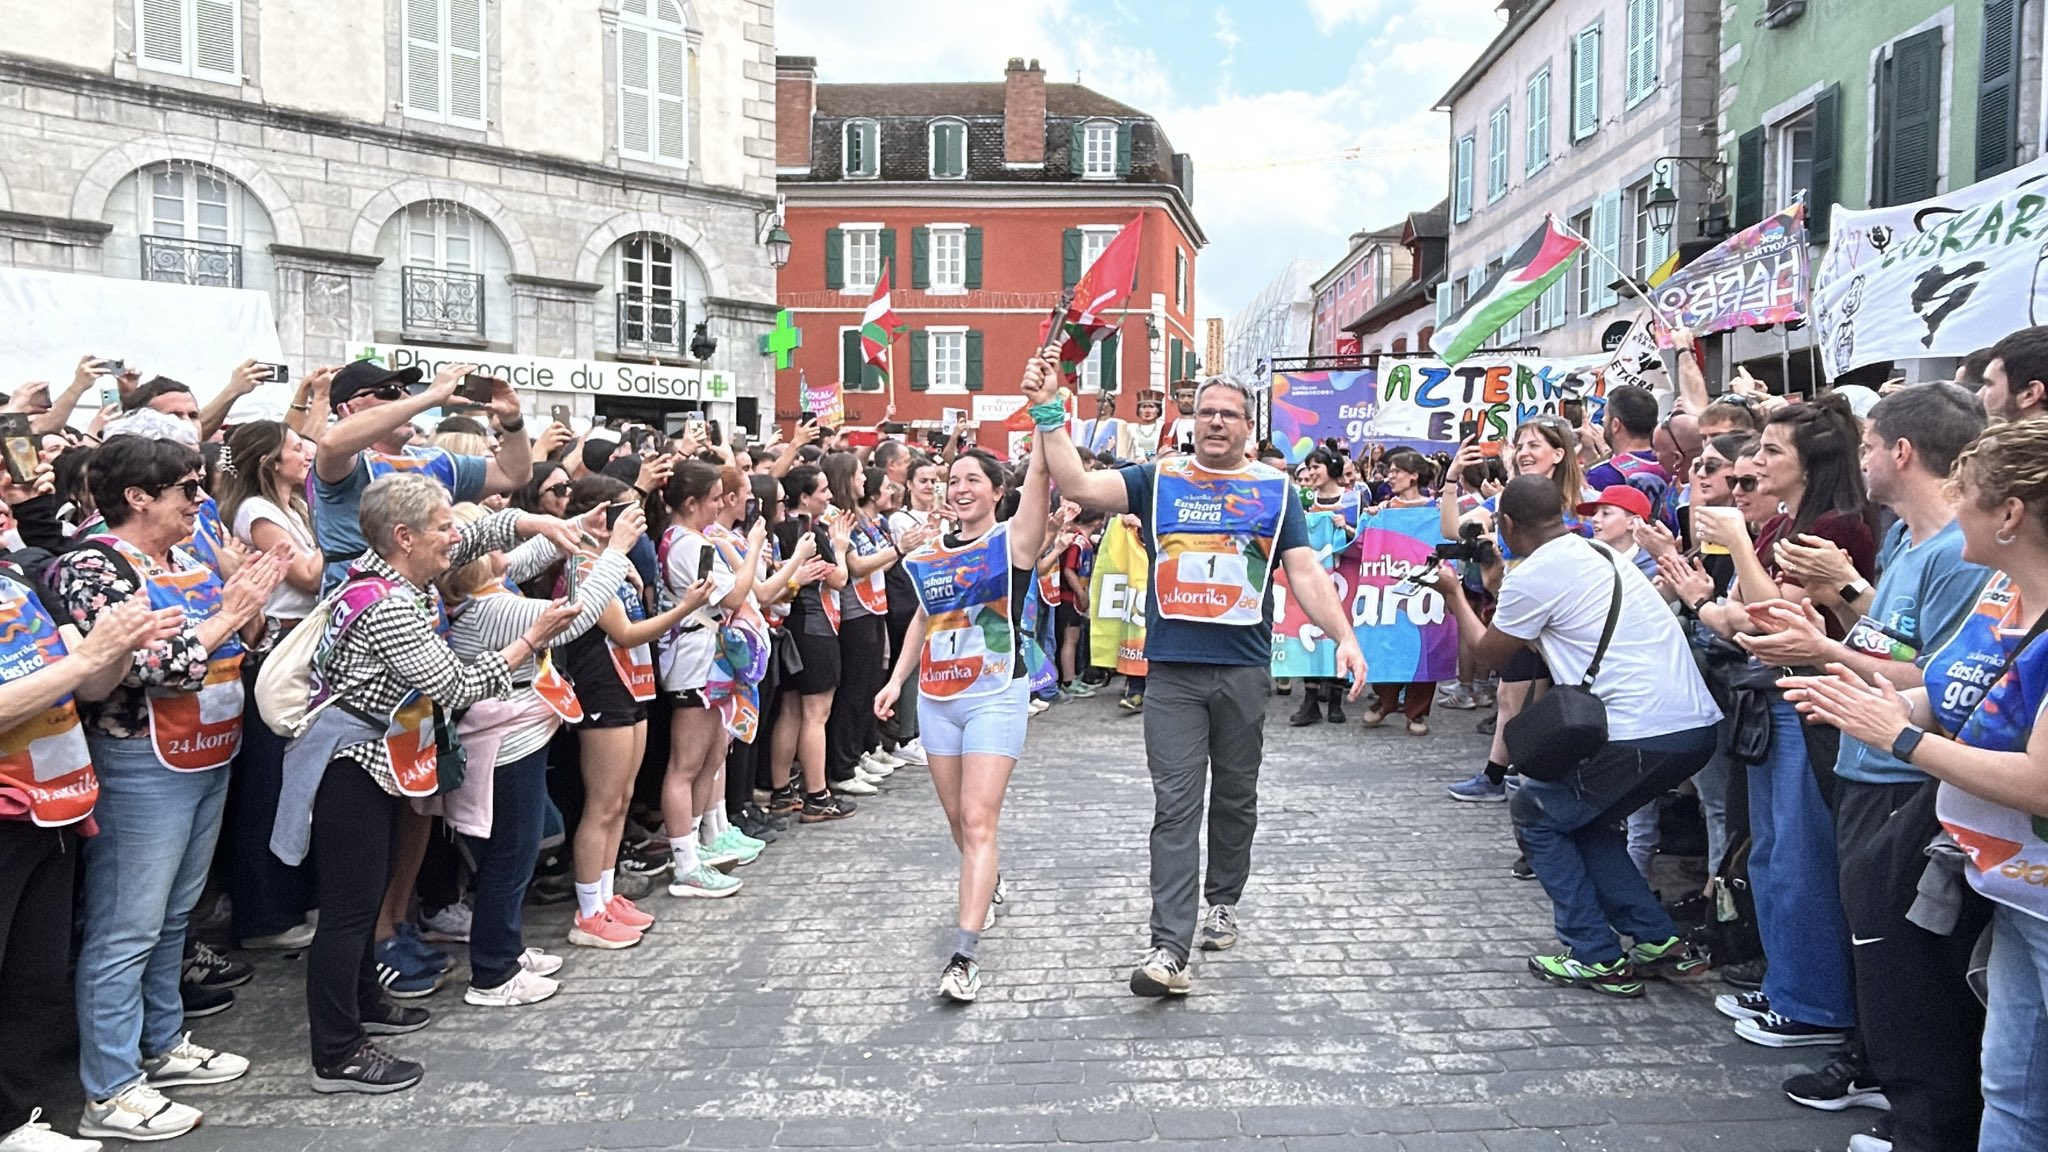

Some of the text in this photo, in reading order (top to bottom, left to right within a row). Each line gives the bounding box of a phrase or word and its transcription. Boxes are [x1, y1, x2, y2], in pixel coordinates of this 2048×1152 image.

[1882, 193, 2048, 269] EUSKAR
[394, 347, 702, 398] Phmacie du Saison
[1610, 360, 1654, 392] ETXERA
[1174, 498, 1222, 512] Euskara
[1178, 508, 1222, 523] gara
[1207, 554, 1217, 579] 1
[1162, 587, 1228, 607] 24.korrika
[950, 631, 956, 655] 1
